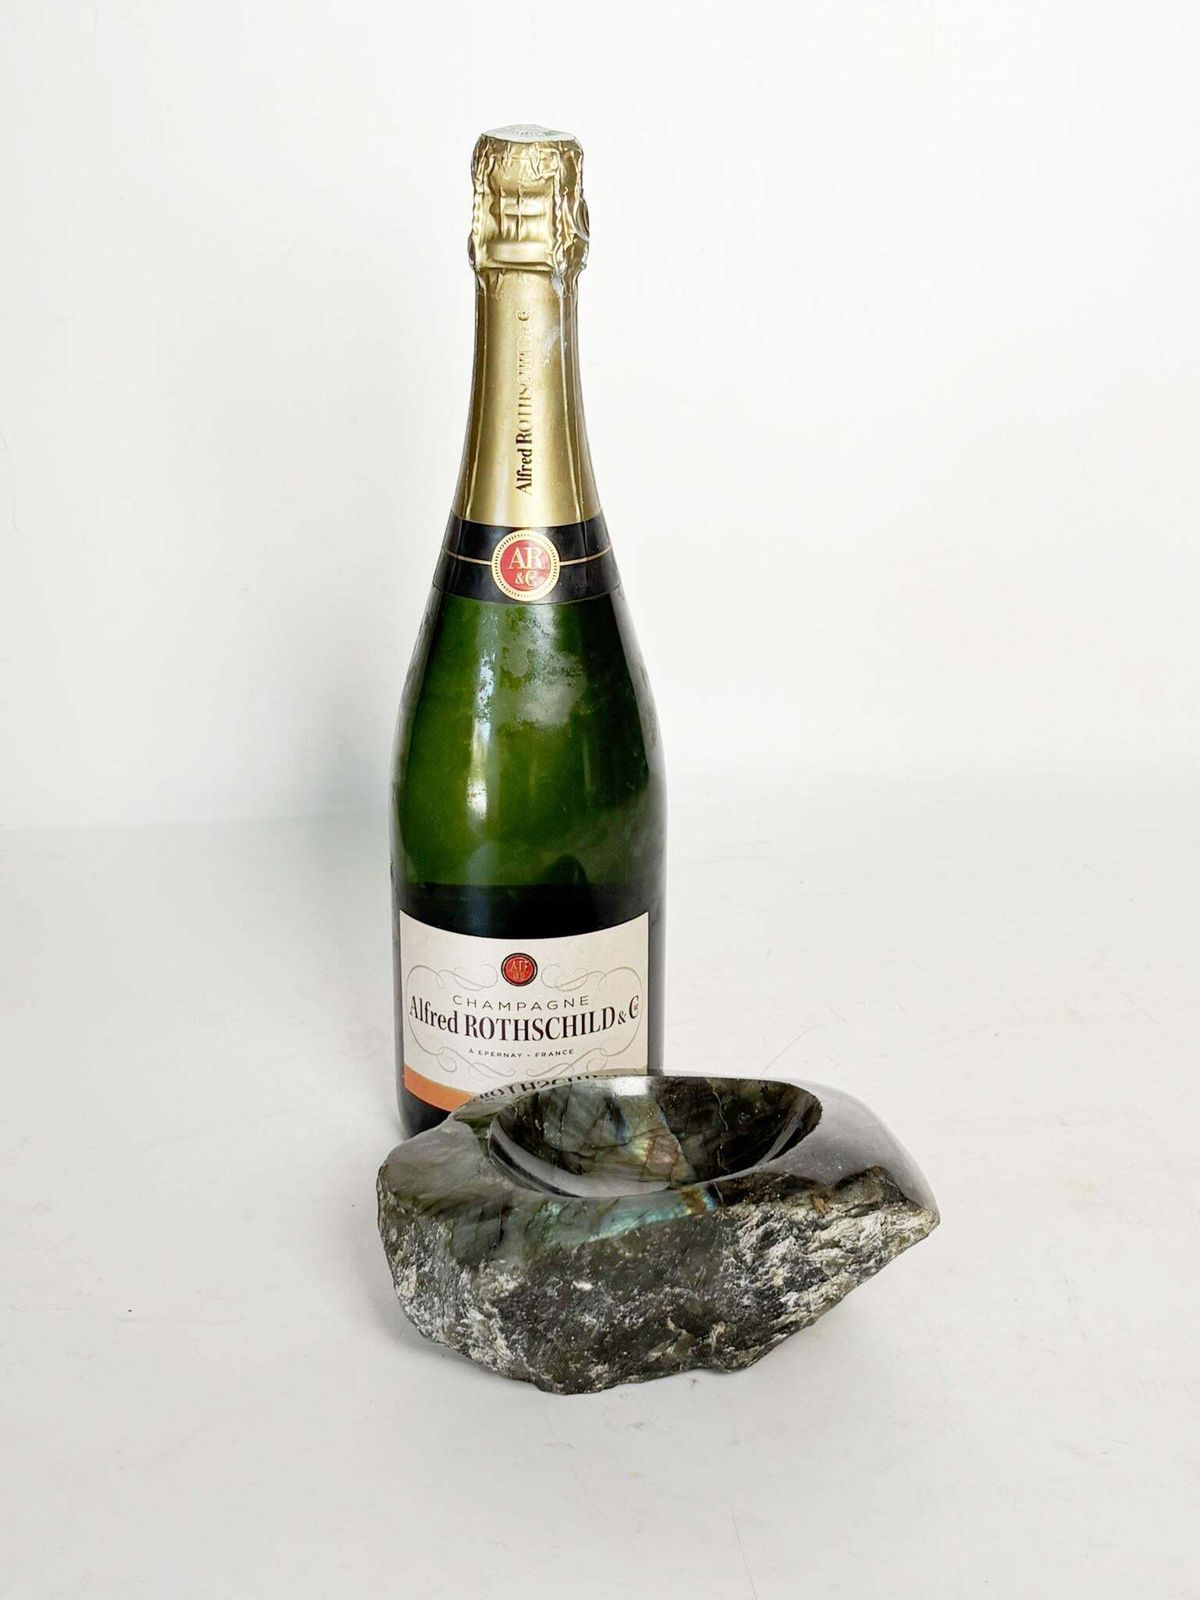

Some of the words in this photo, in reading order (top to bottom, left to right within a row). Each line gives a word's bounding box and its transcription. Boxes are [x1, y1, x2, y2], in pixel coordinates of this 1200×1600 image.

[516, 448, 533, 495] Alfred
[507, 546, 545, 570] AR
[452, 995, 590, 1012] CHAMPAGNE
[409, 995, 459, 1035] Alfred
[464, 1005, 616, 1043] ROTHSCHILD
[534, 1048, 574, 1058] FRANCE
